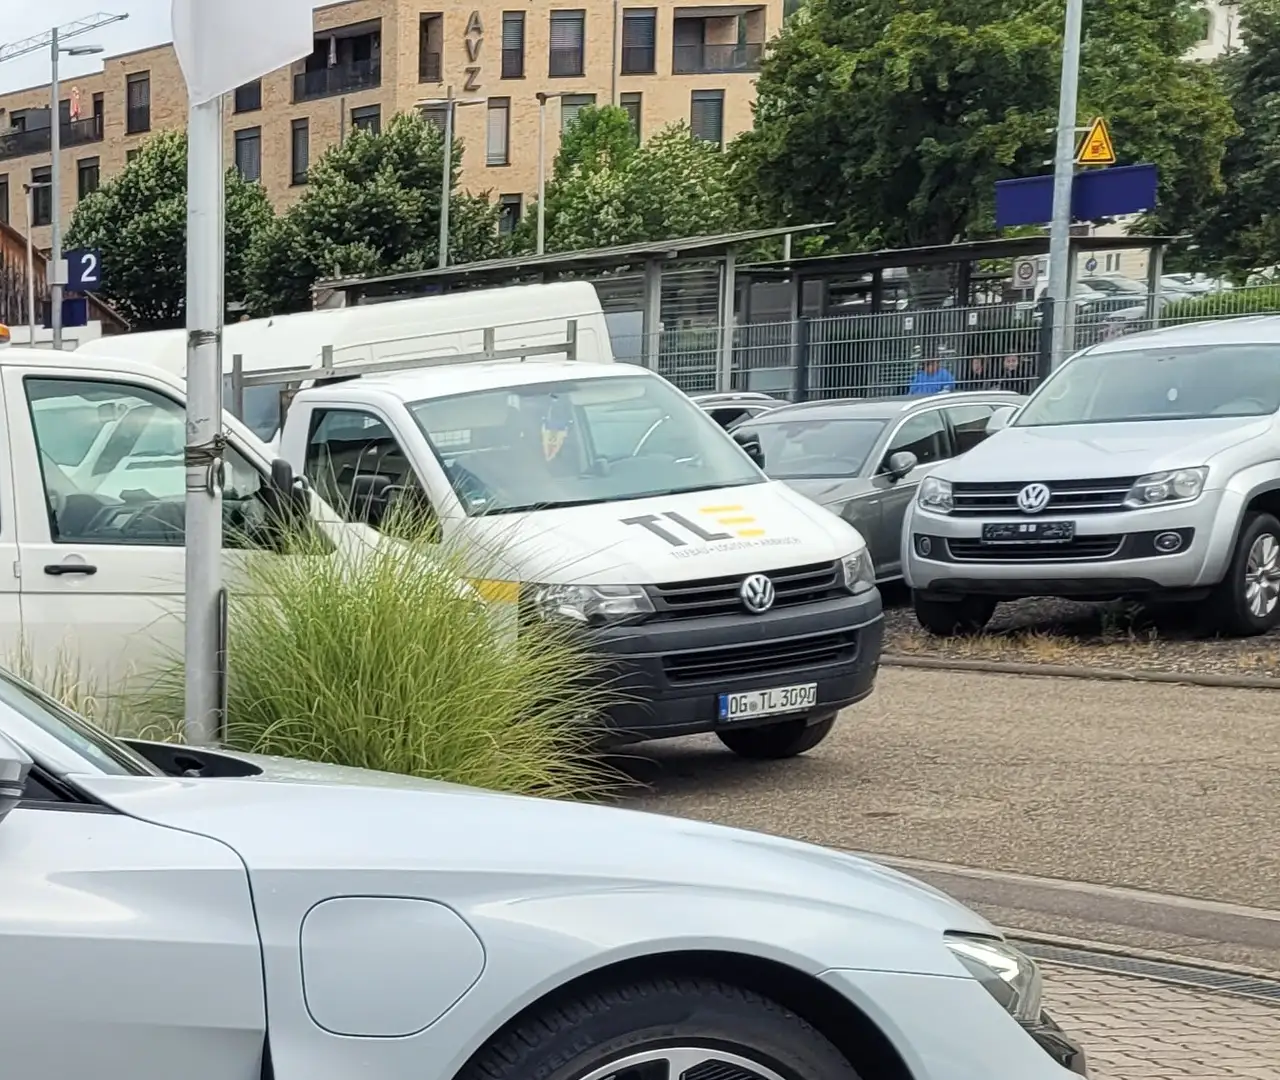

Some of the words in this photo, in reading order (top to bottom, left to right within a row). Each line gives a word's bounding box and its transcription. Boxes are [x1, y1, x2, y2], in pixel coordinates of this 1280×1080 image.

[463, 10, 484, 92] AVZ
[81, 253, 97, 282] 2
[730, 695, 748, 715] OG
[759, 691, 777, 710] TL
[780, 685, 817, 707] 3090
